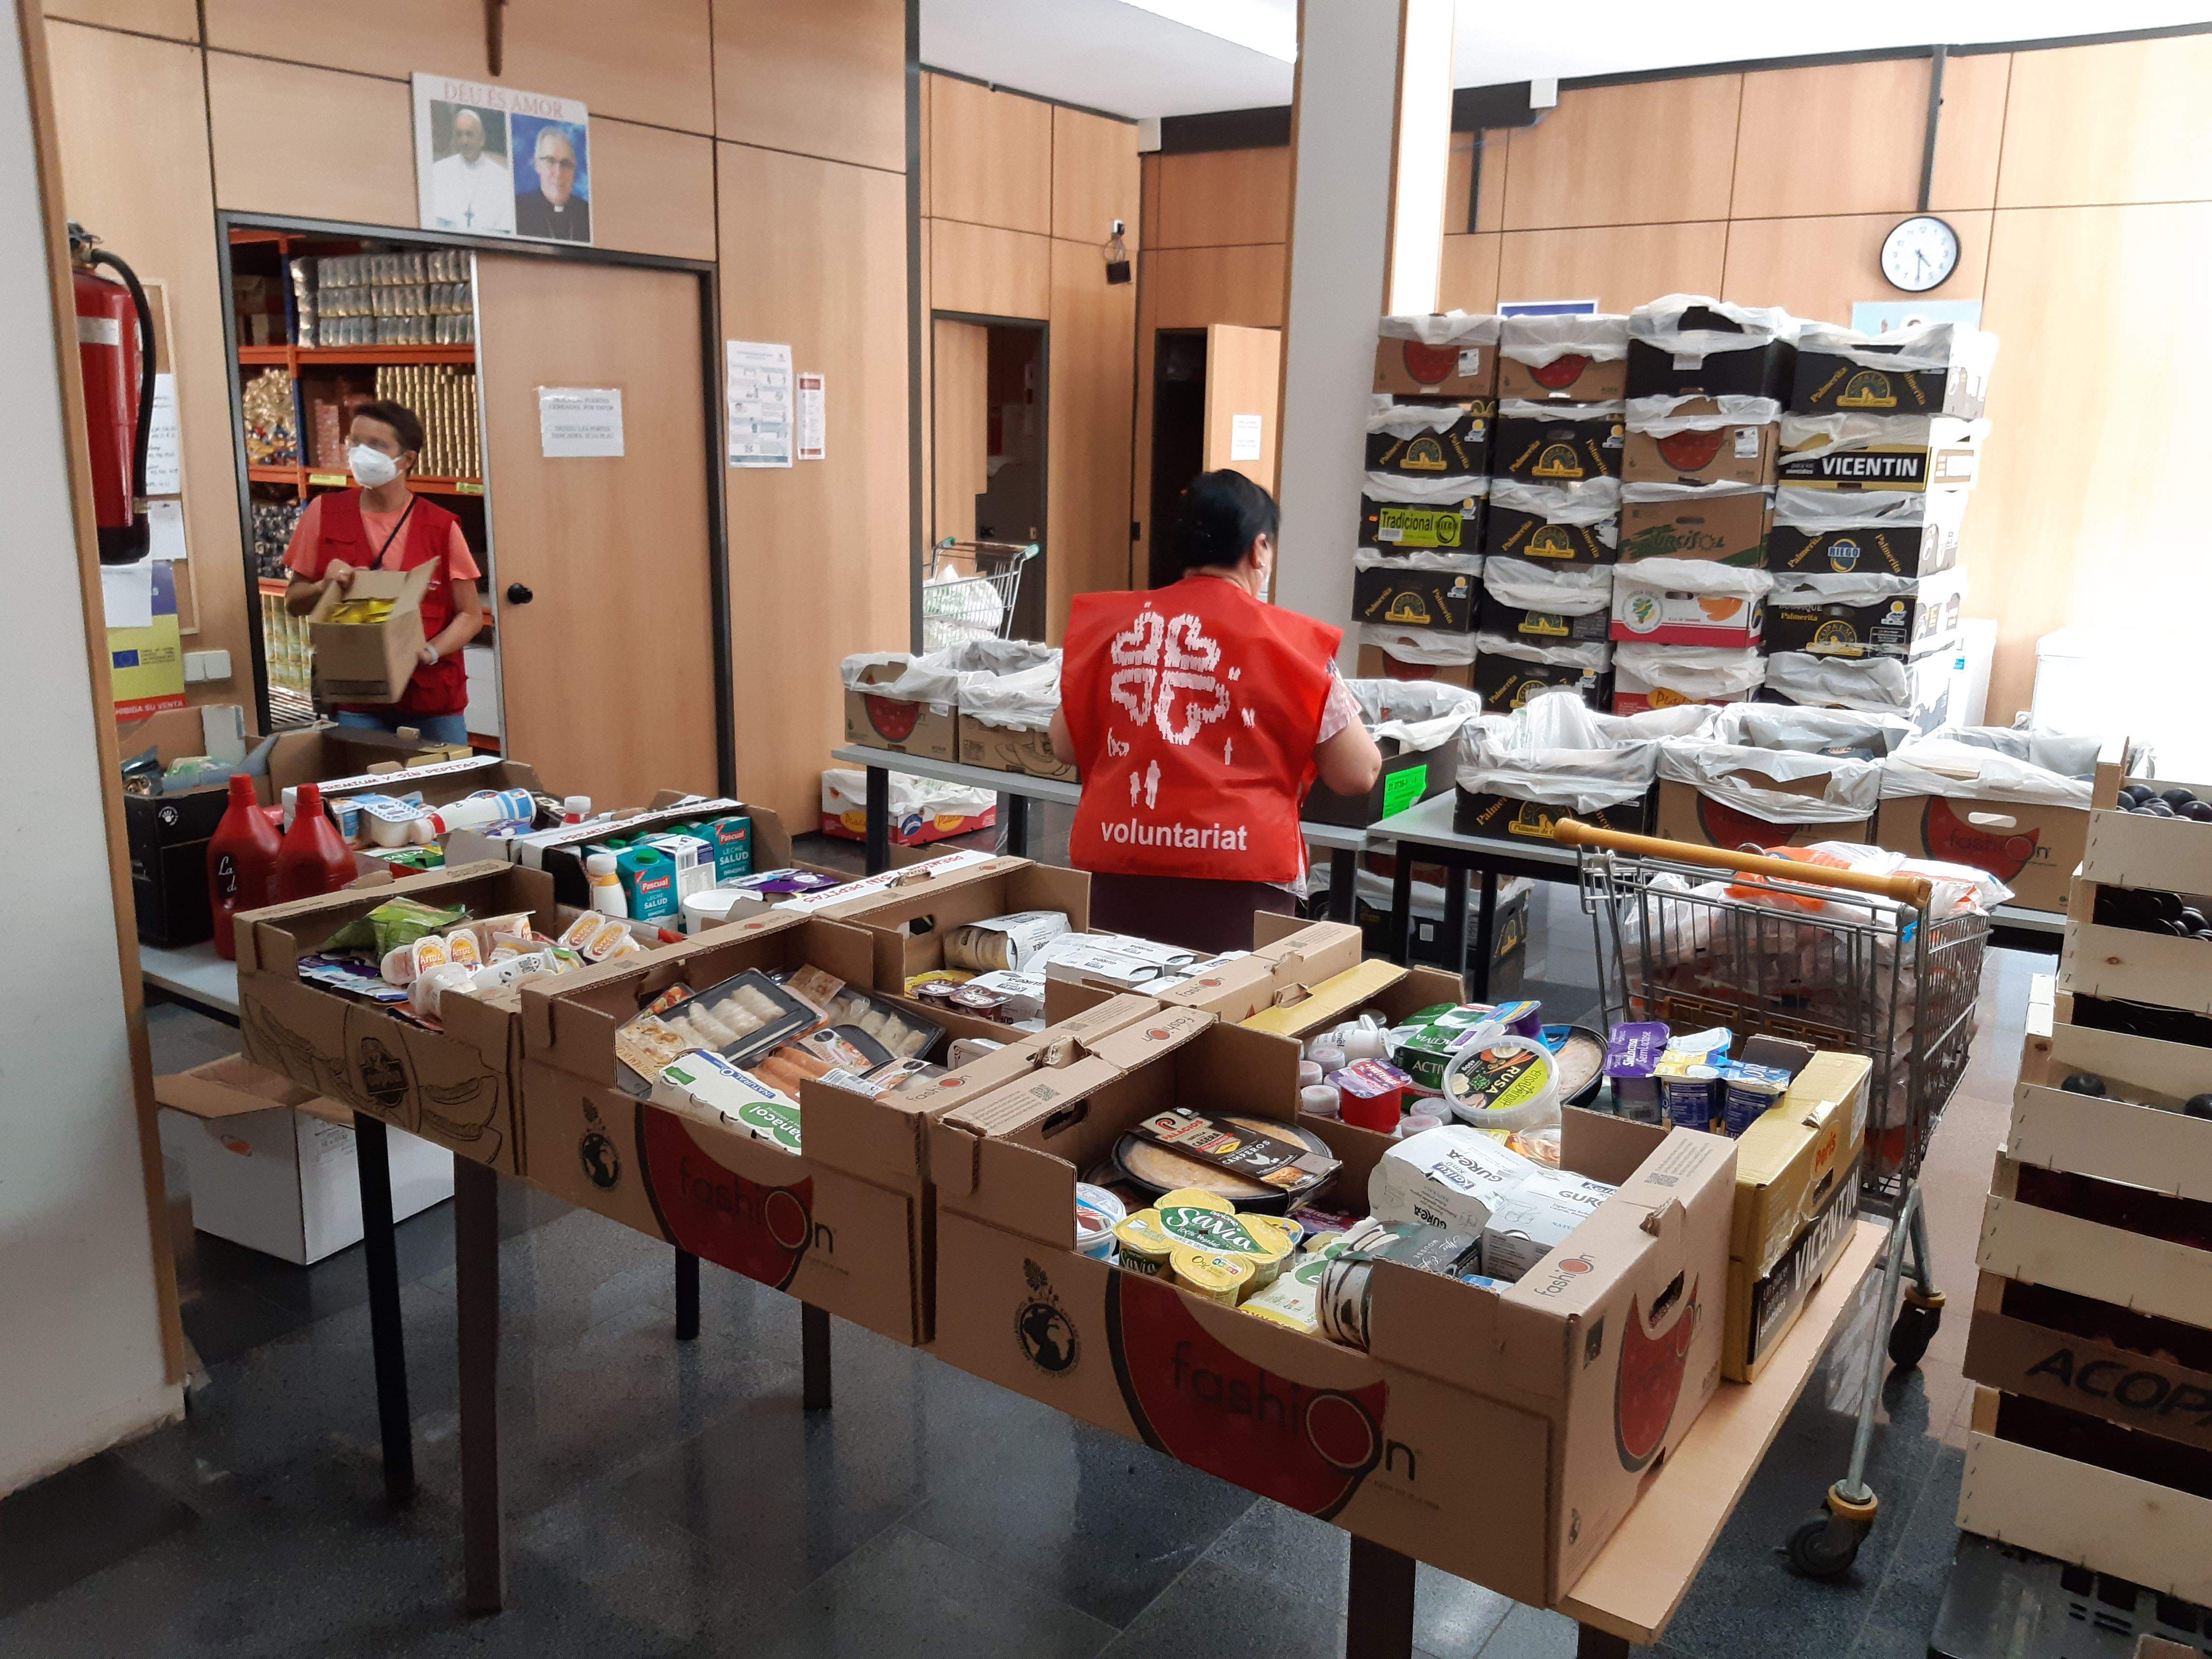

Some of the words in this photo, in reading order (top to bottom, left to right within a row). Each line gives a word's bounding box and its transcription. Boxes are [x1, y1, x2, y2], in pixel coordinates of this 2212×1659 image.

[511, 95, 565, 119] AMOR
[1822, 457, 1919, 477] VICENTIN
[1382, 511, 1433, 531] Tradicional
[1874, 533, 1901, 574] Palmerita
[1780, 612, 1818, 622] Palmerita
[1489, 674, 1517, 704] Palmerita
[424, 761, 479, 774] PEPITAS
[1475, 796, 1508, 826] Palmer
[559, 823, 623, 841] PREMIUM
[720, 830, 745, 842] Pascual
[1101, 817, 1249, 852] voluntariat
[720, 851, 749, 865] SALUD
[723, 845, 744, 855] LECHE
[642, 878, 668, 891] Pascual
[865, 875, 893, 886] SIN
[647, 893, 663, 902] LECHE
[802, 883, 864, 904] PEPITAS
[644, 898, 668, 909] SALUD
[420, 954, 442, 965] Arroz
[452, 946, 472, 956] Arroz
[1412, 1059, 1445, 1074] ACTIV
[1461, 1059, 1476, 1071] 450g
[1485, 1065, 1521, 1094] RUSA
[1161, 1118, 1204, 1141] PALACIOS
[1191, 1131, 1222, 1147] CASERA
[1222, 1140, 1271, 1165] CAMPEROS
[1431, 1161, 1476, 1190] Kaiku
[1166, 1207, 1252, 1250] Savia
[1551, 1221, 1572, 1230] NATU
[1795, 1166, 1860, 1292] VICENTIN
[1413, 1239, 1439, 1259] MOUSSE
[1120, 1250, 1156, 1275] Savia
[1191, 1255, 1206, 1270] 0%
[2025, 1347, 2212, 1430] ACOP
